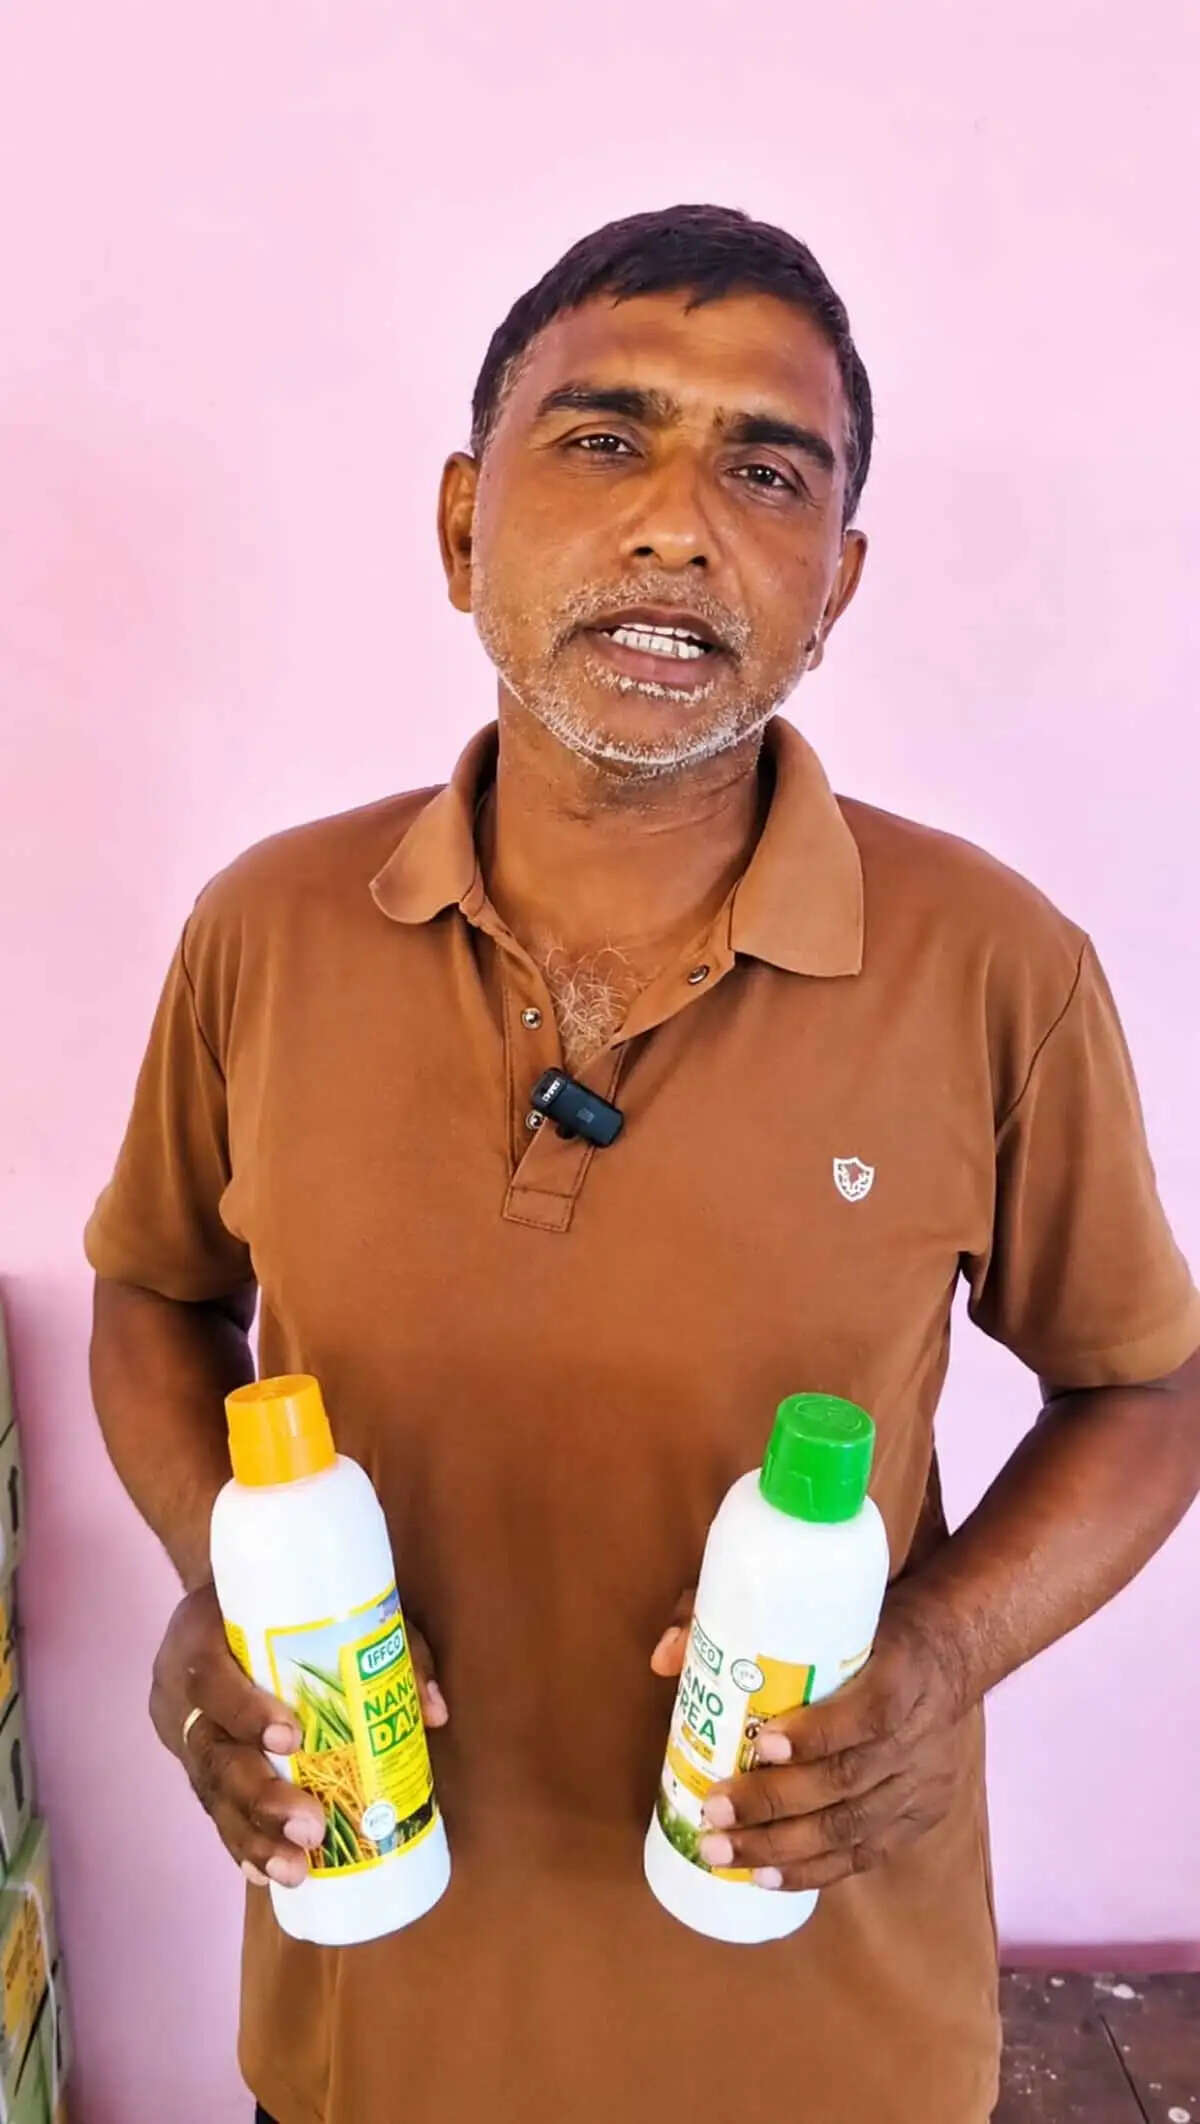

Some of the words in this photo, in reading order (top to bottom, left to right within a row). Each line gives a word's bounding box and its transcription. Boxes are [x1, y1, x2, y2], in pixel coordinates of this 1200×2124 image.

[366, 1633, 402, 1669] IFFCO
[678, 1685, 716, 1747] REA
[683, 1665, 724, 1716] ANO
